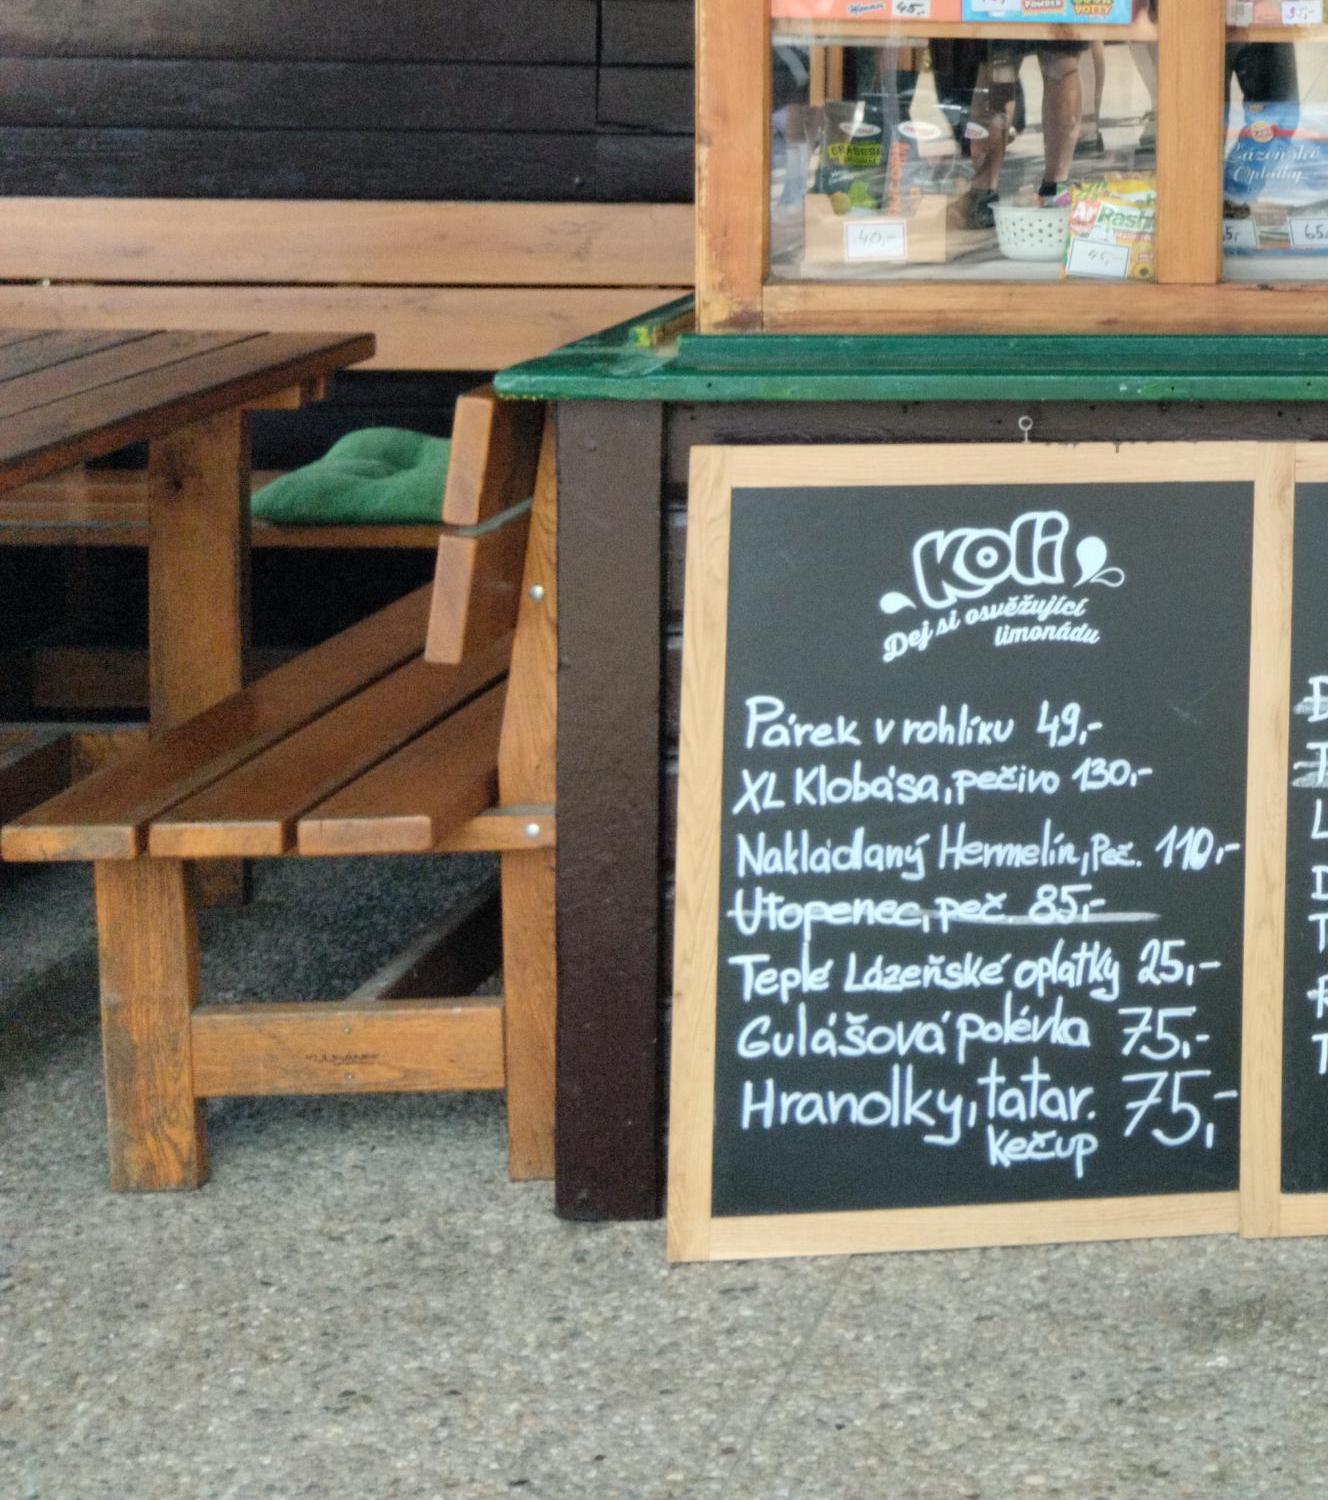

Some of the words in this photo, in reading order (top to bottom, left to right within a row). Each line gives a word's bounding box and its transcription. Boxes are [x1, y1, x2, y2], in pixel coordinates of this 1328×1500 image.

[882, 621, 933, 663] Dej
[935, 610, 961, 636] si
[965, 594, 1090, 625] osvěžující
[993, 621, 1101, 646] limonádu
[745, 696, 862, 748] Párek
[902, 704, 1015, 746] rohlíku
[732, 768, 786, 814] XL
[736, 825, 930, 880] Nakládaný
[1014, 939, 1119, 1001] oplatky
[737, 1003, 951, 1058] Gulášová
